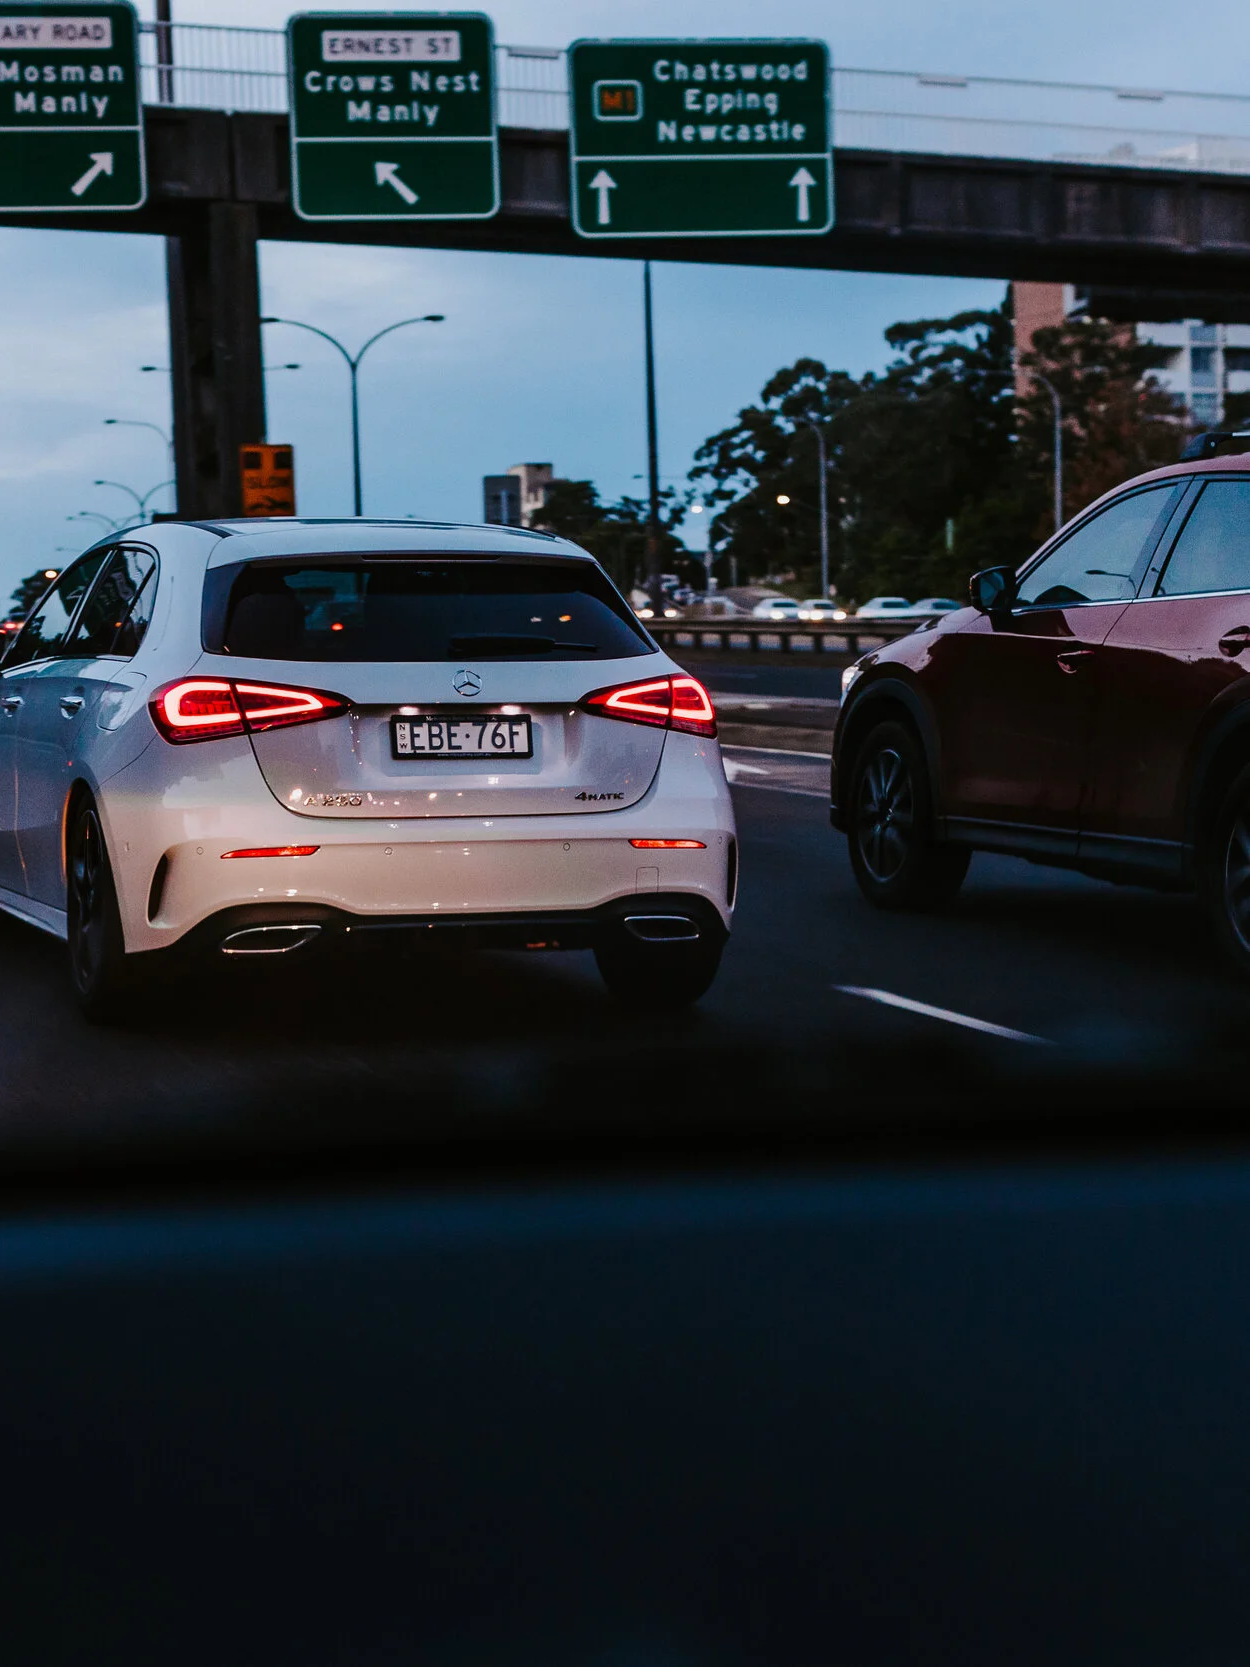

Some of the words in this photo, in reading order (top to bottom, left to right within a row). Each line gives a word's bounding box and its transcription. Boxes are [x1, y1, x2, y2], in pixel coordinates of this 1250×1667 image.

[53, 25, 104, 41] ROAD
[328, 38, 414, 55] ERNEST
[428, 38, 452, 55] ST
[654, 60, 807, 81] Chatswood
[305, 71, 394, 92] Crows
[411, 71, 479, 92] Nest
[14, 92, 108, 118] Manly
[602, 89, 635, 112] M1
[685, 89, 778, 115] Epping
[348, 101, 439, 125] Manly
[658, 121, 805, 141] Newcastle
